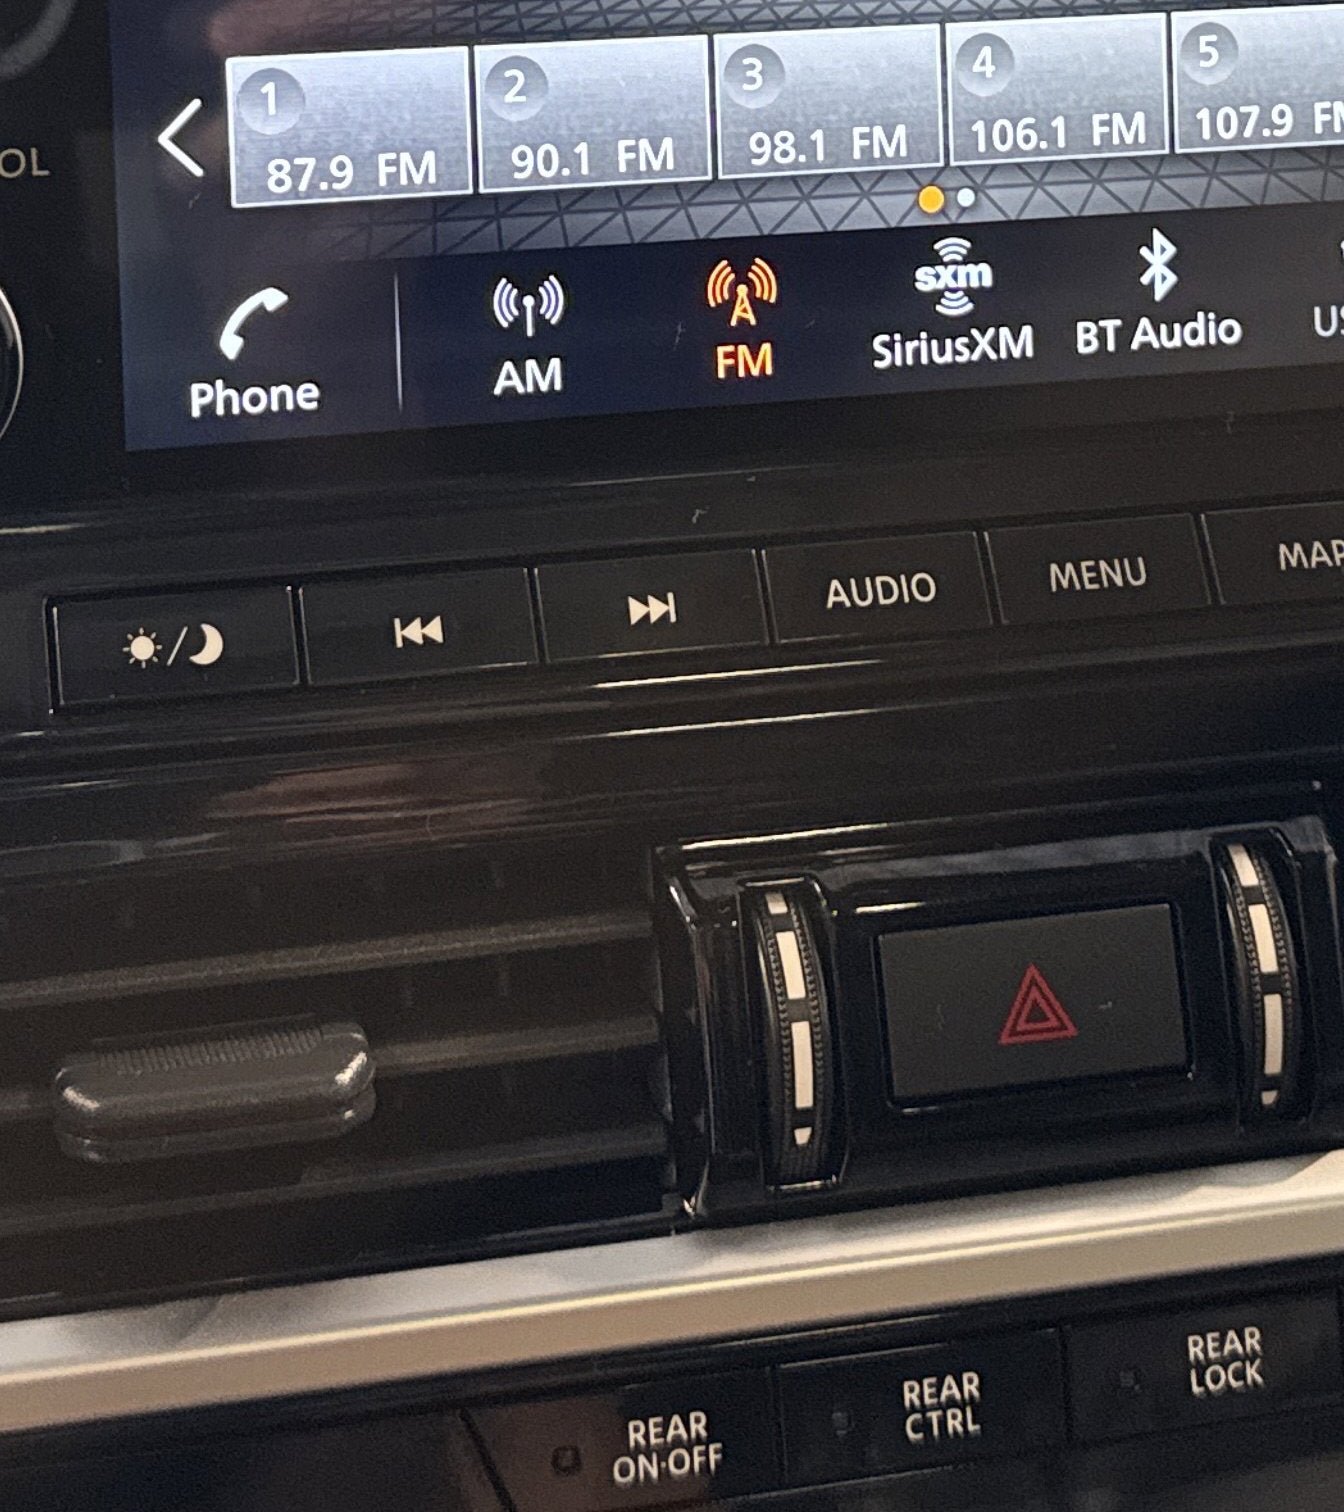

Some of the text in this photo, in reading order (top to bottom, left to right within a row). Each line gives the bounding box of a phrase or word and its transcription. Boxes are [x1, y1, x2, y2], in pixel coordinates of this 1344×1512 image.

[972, 45, 996, 78] 4
[1199, 34, 1220, 67] 5
[503, 69, 528, 103] 2
[742, 57, 763, 90] 3
[258, 81, 277, 115] 1
[971, 110, 1146, 153] 106.1 FM
[1195, 103, 1294, 140] 107.9
[510, 136, 675, 180] 90.1 FM
[748, 123, 908, 166] 98.1 FM
[266, 149, 437, 194] 87.9 FM
[872, 324, 1034, 369] SiriusXM
[1076, 311, 1242, 355] BT Audio
[493, 357, 562, 396] AM
[716, 342, 773, 379] FM
[190, 379, 320, 418] Phone
[826, 572, 936, 609] AUDIO
[1049, 556, 1147, 592] MENU
[1187, 1326, 1262, 1362] REAR
[903, 1371, 981, 1408] REAR
[1189, 1359, 1264, 1396] LOCK
[628, 1411, 709, 1449] REAR
[904, 1405, 981, 1443] CTRL
